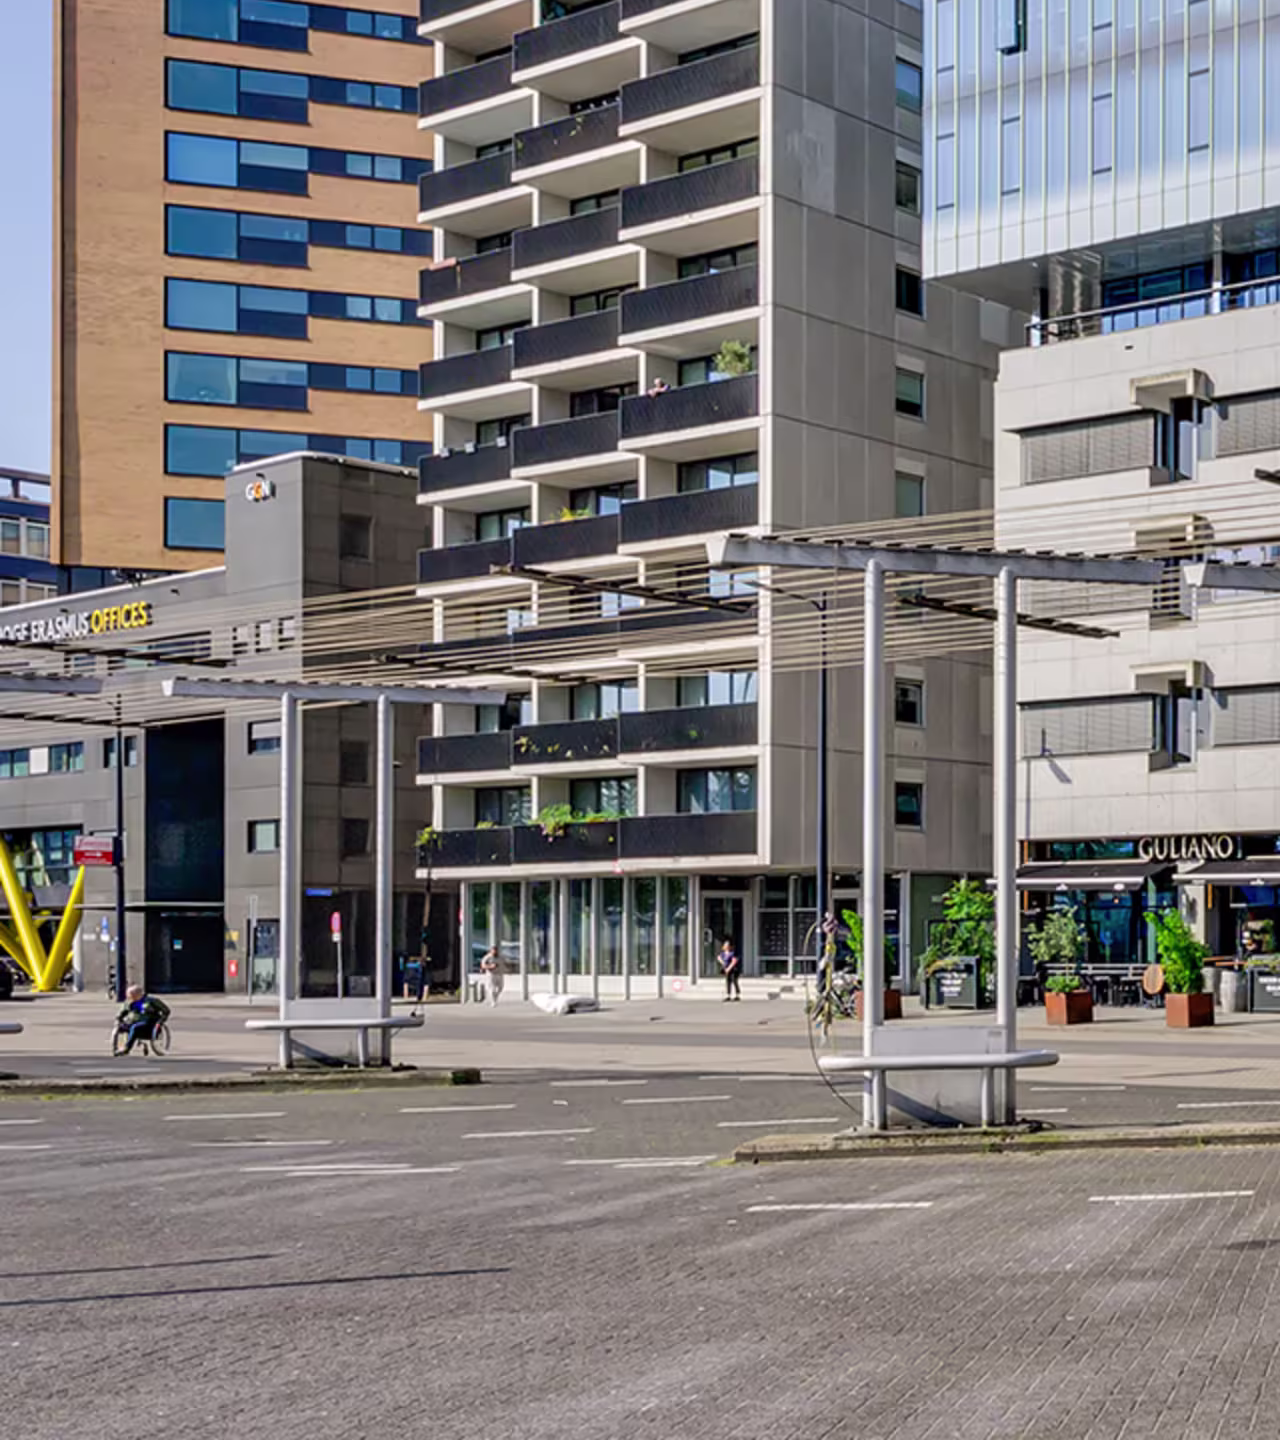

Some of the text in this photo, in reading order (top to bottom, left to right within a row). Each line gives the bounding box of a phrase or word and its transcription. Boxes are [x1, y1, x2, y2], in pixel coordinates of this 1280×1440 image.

[0, 601, 147, 642] OGE ERASMUS OFFICES
[1138, 834, 1234, 860] GULIANO
